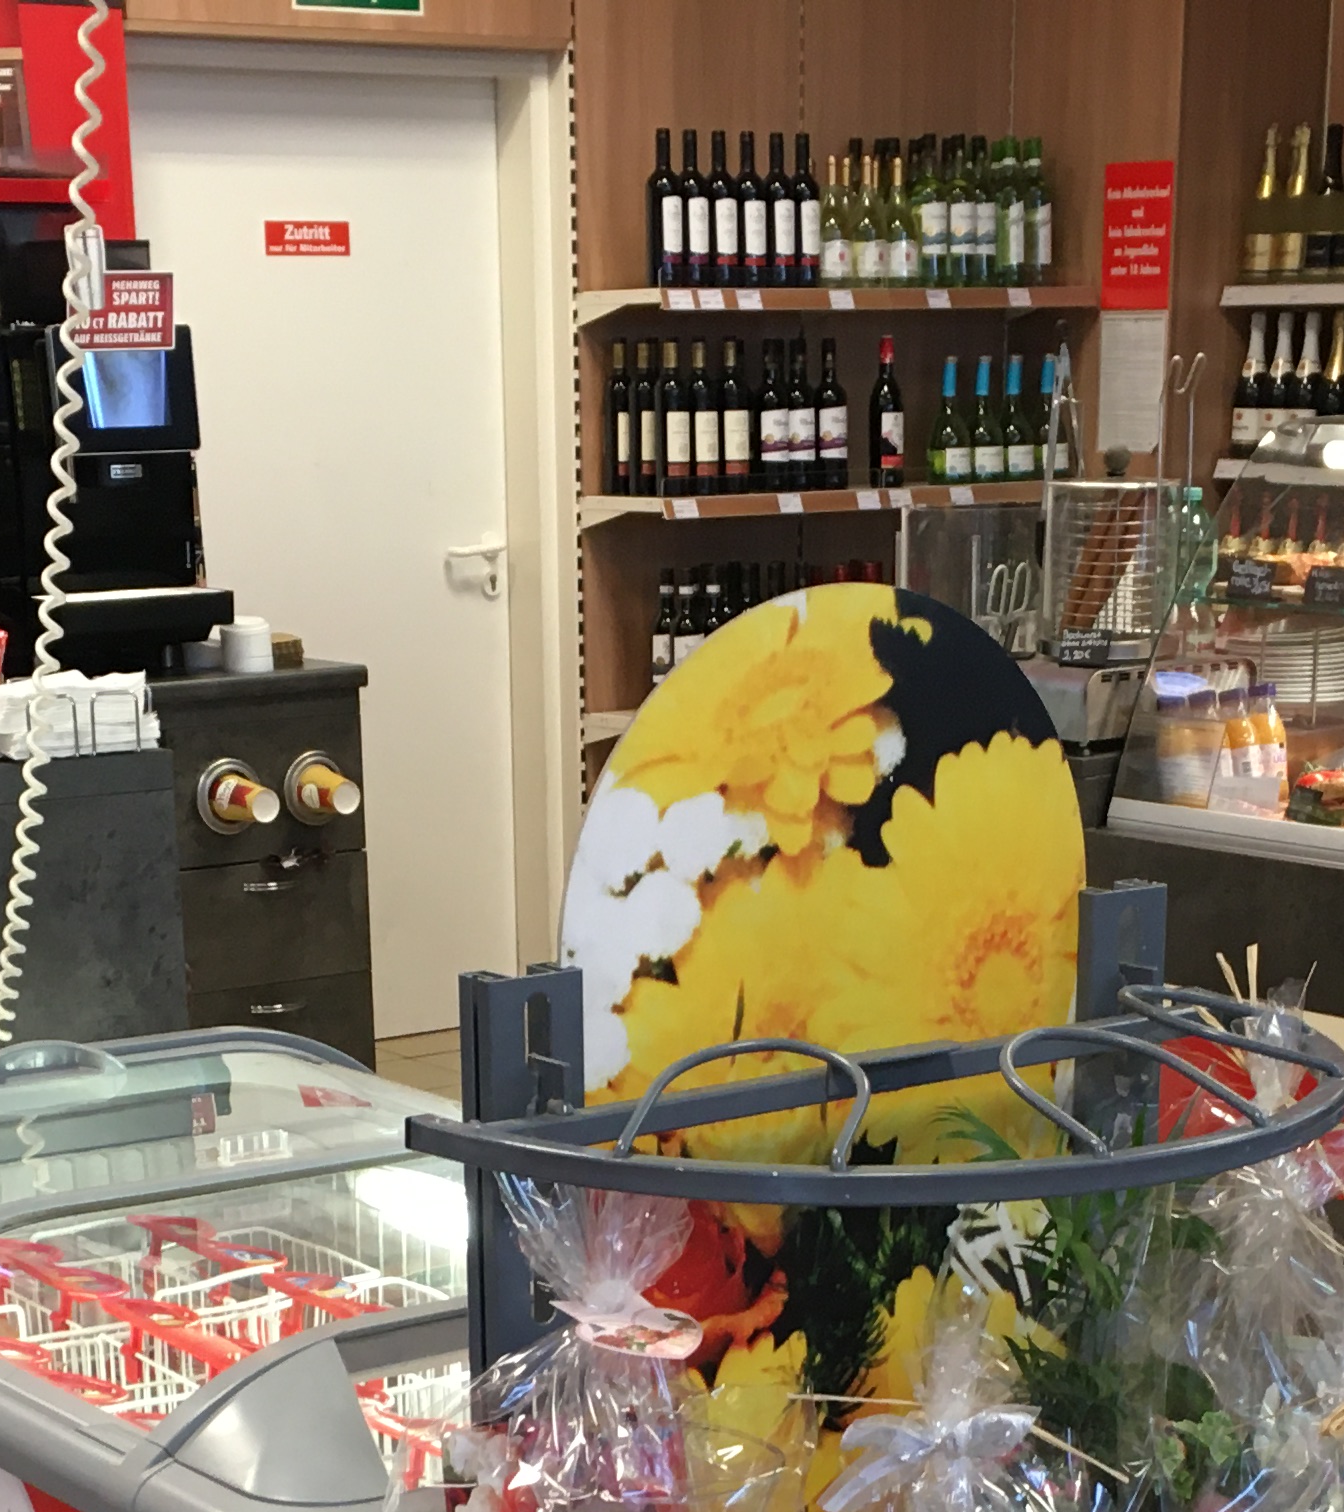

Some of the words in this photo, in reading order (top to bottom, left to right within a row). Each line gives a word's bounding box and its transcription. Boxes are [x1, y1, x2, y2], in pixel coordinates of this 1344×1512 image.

[284, 224, 331, 240] Zutritt
[299, 243, 346, 253] Mitarbeiter
[112, 280, 160, 291] MEHRWEG
[112, 291, 160, 305] SPART!
[108, 311, 164, 329] RABATT
[74, 333, 90, 344] AUF
[93, 331, 162, 343] HEISSGETRÄNKE
